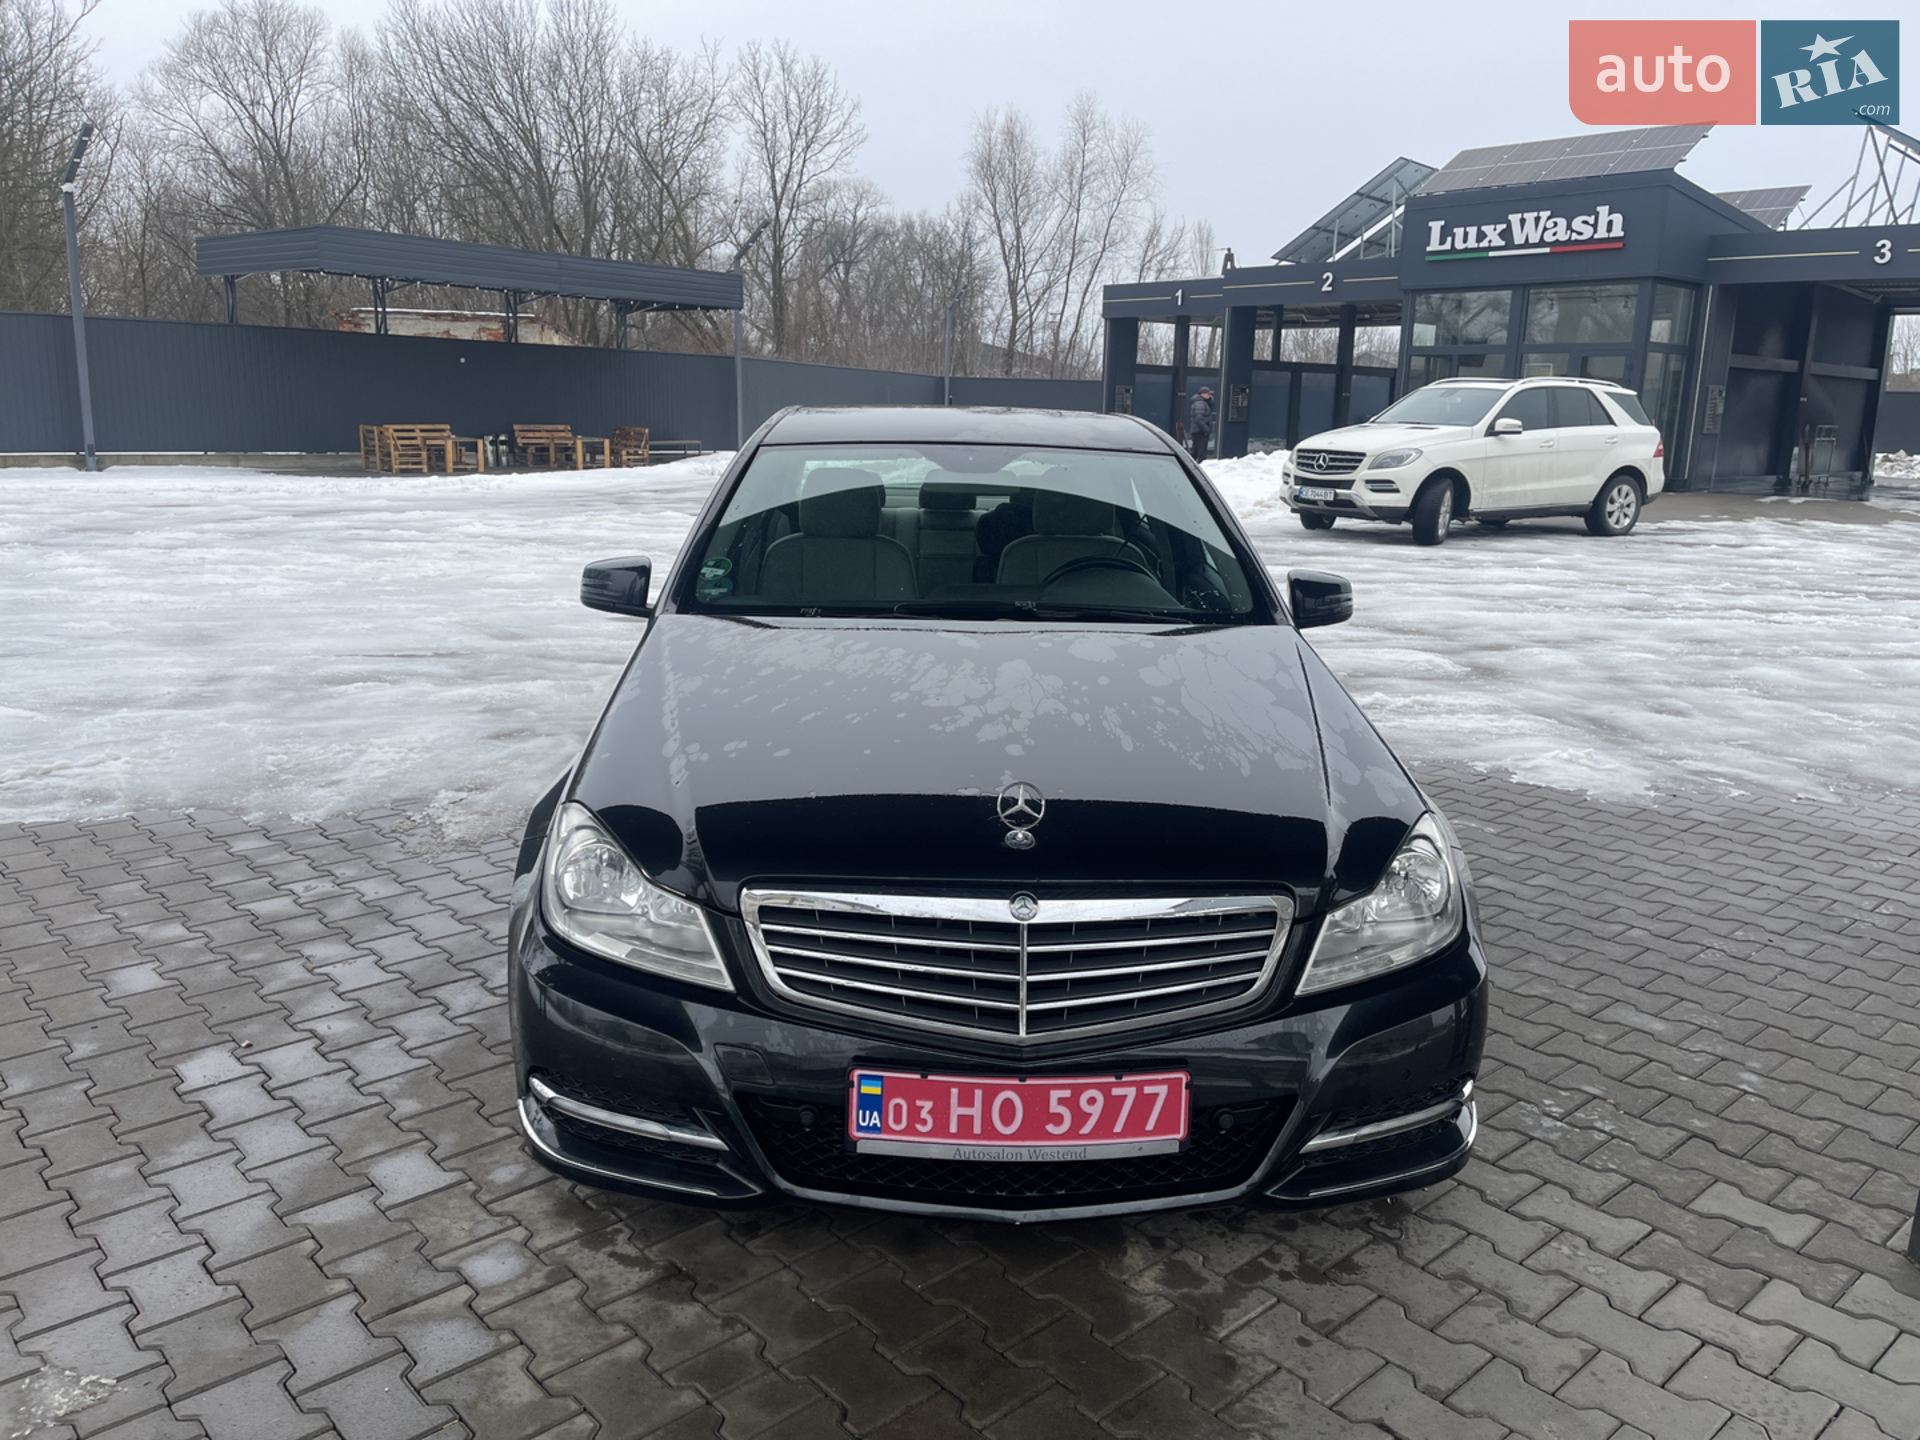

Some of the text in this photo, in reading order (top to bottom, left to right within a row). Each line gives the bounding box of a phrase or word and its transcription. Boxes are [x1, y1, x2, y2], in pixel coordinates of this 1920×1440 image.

[1426, 205, 1625, 252] LuxWash
[1873, 239, 1892, 265] 3
[1321, 272, 1334, 292] 2
[1175, 288, 1183, 307] 1
[859, 1109, 881, 1128] UA
[888, 1084, 1169, 1136] 03 HO 5977
[952, 1146, 1087, 1161] Autosalon Westend
